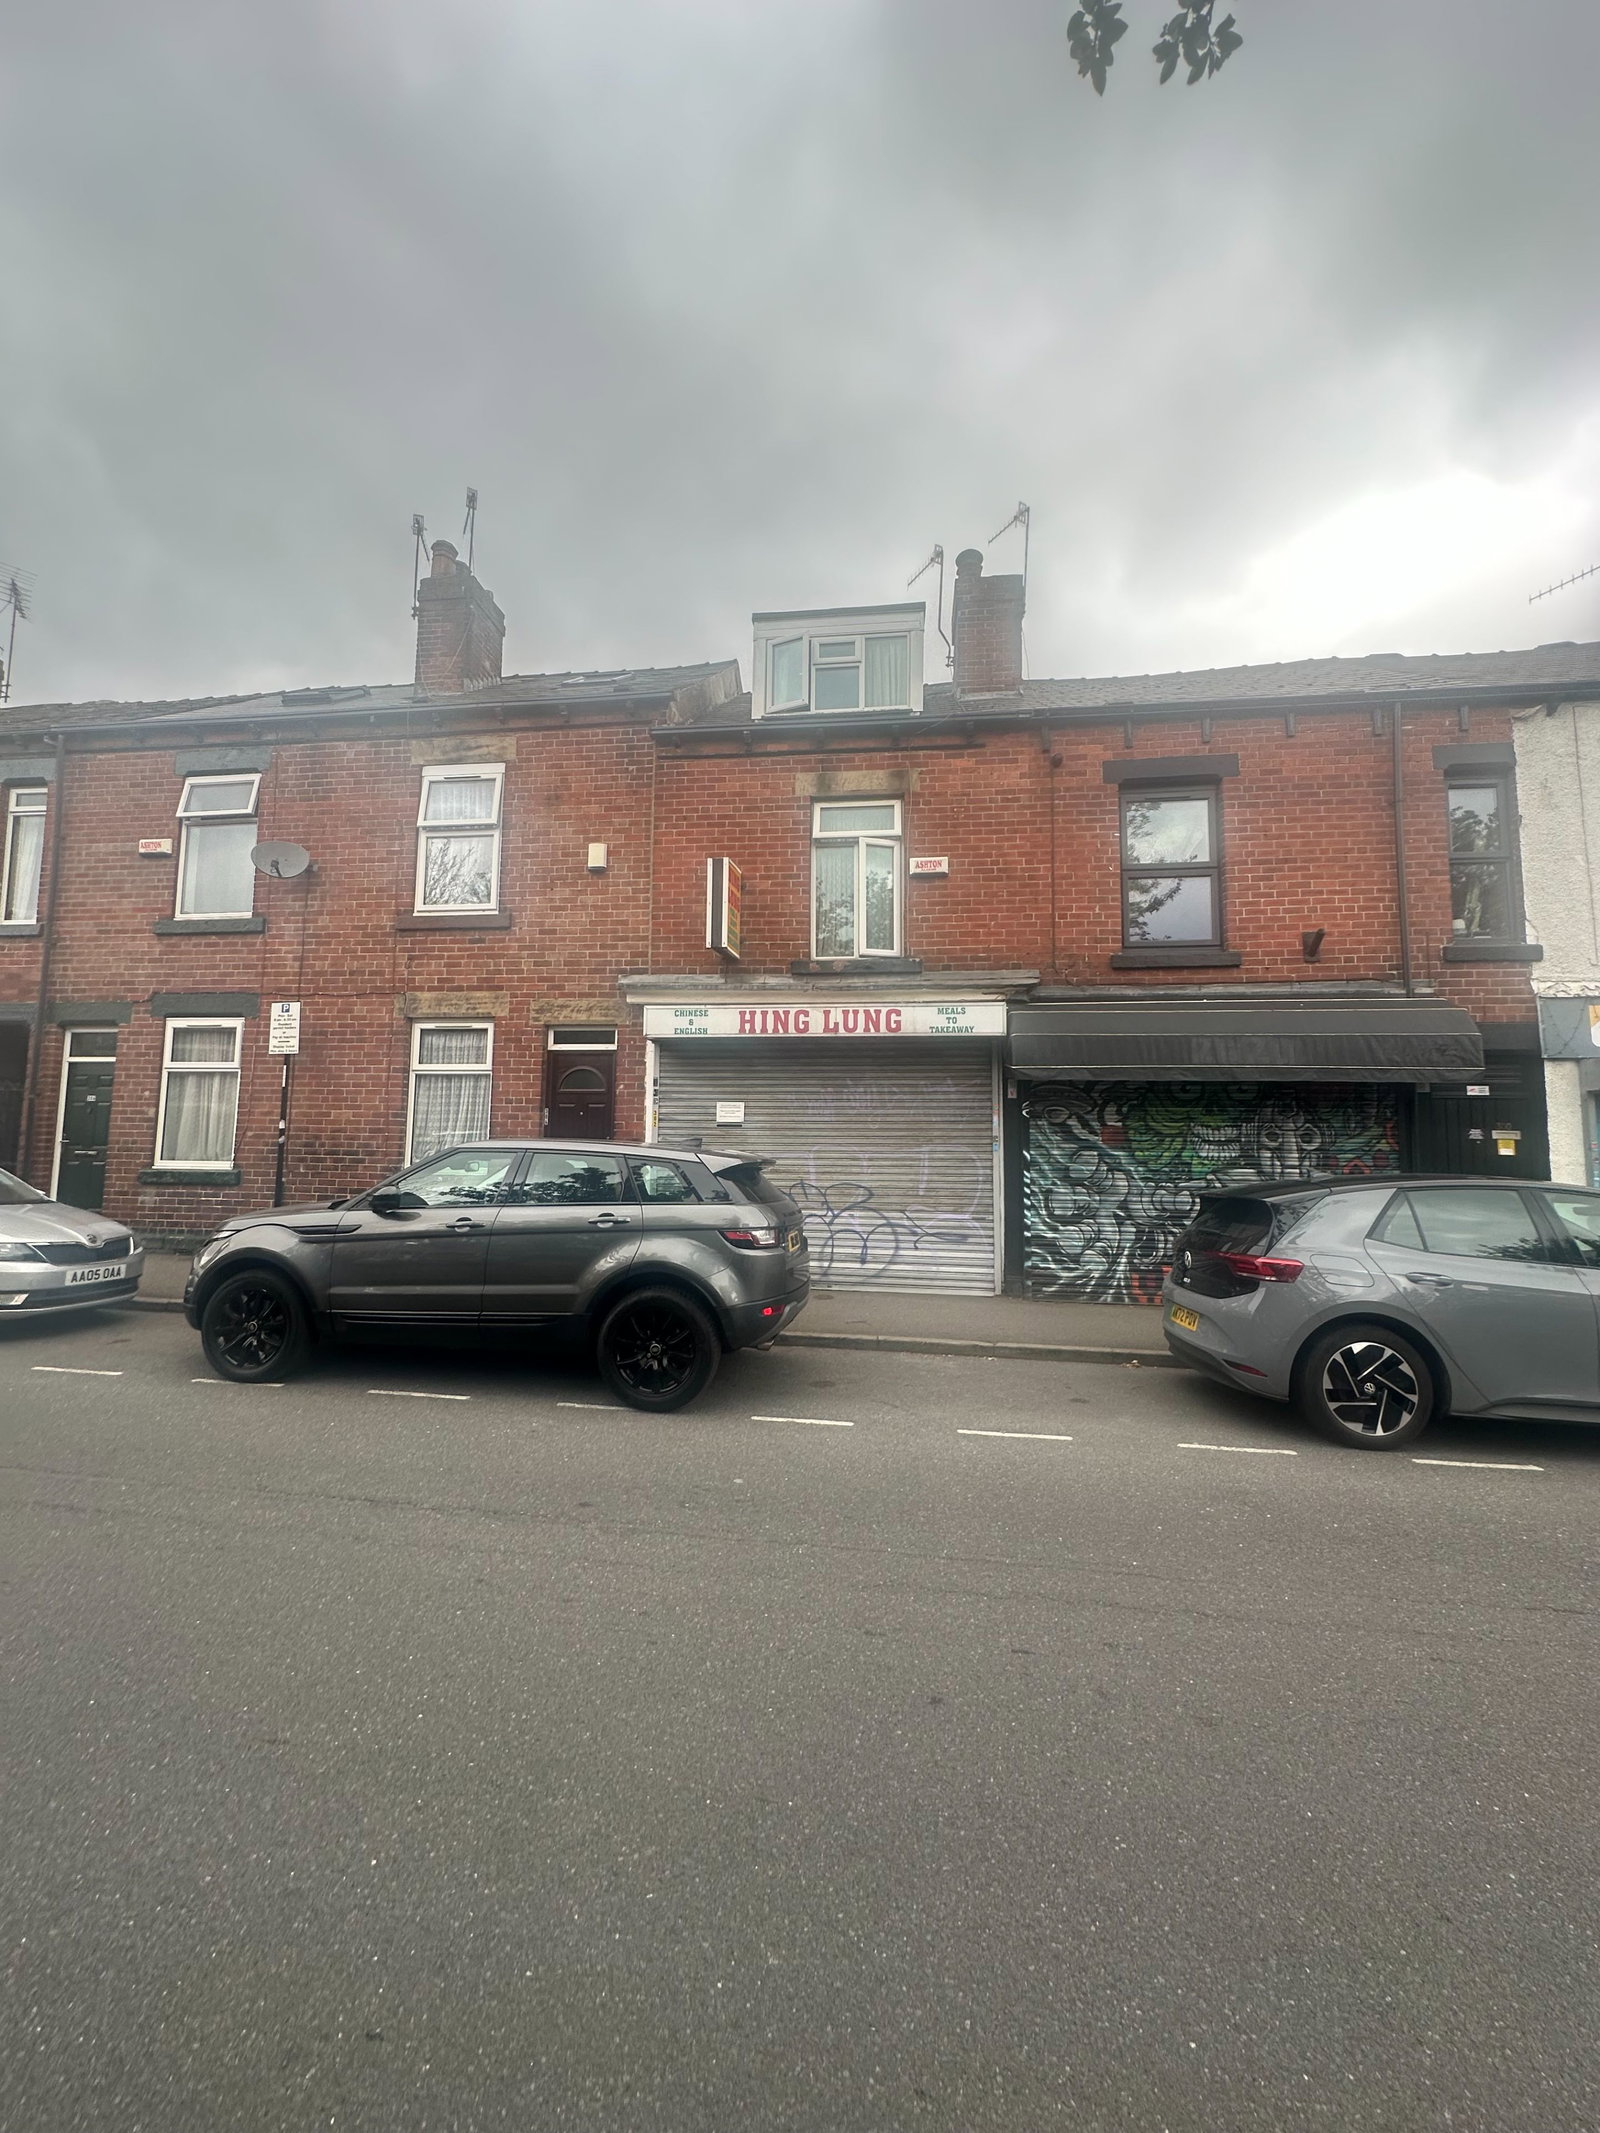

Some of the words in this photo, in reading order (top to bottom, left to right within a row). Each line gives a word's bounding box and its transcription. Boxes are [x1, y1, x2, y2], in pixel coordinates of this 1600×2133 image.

[141, 841, 162, 849] ASHTON
[915, 860, 943, 869] ASHTON
[674, 1009, 709, 1017] CHINESE
[937, 1007, 966, 1015] MEALS
[688, 1018, 694, 1026] &
[738, 1009, 810, 1034] HING
[823, 1008, 902, 1034] LUNG
[946, 1017, 958, 1025] TO
[674, 1027, 708, 1035] ENGLISH
[929, 1026, 975, 1034] TAKEAWAY
[70, 1269, 101, 1283] AA05
